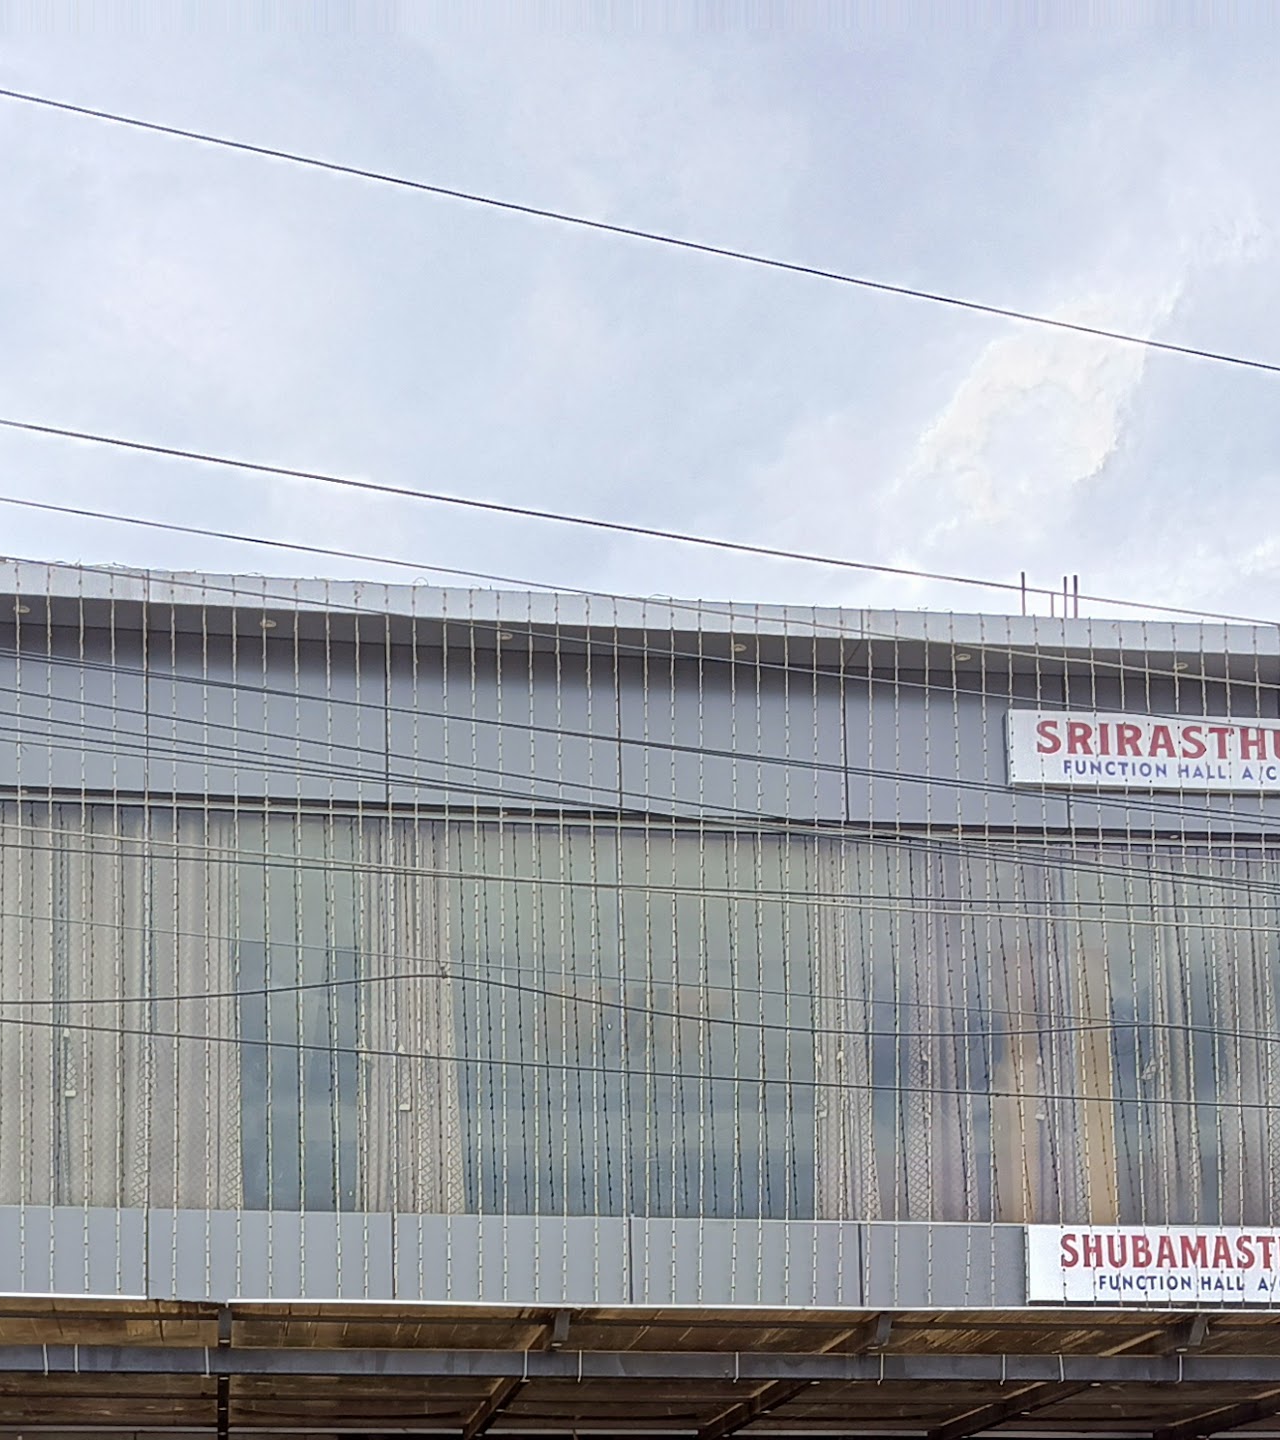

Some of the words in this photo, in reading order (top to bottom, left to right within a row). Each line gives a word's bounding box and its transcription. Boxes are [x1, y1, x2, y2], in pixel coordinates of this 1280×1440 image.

[1063, 760, 1169, 779] FUNCTION
[1177, 763, 1227, 781] HALL
[1241, 764, 1278, 782] A/C
[1098, 1275, 1193, 1292] FUNCTION
[1200, 1275, 1245, 1293] HALL
